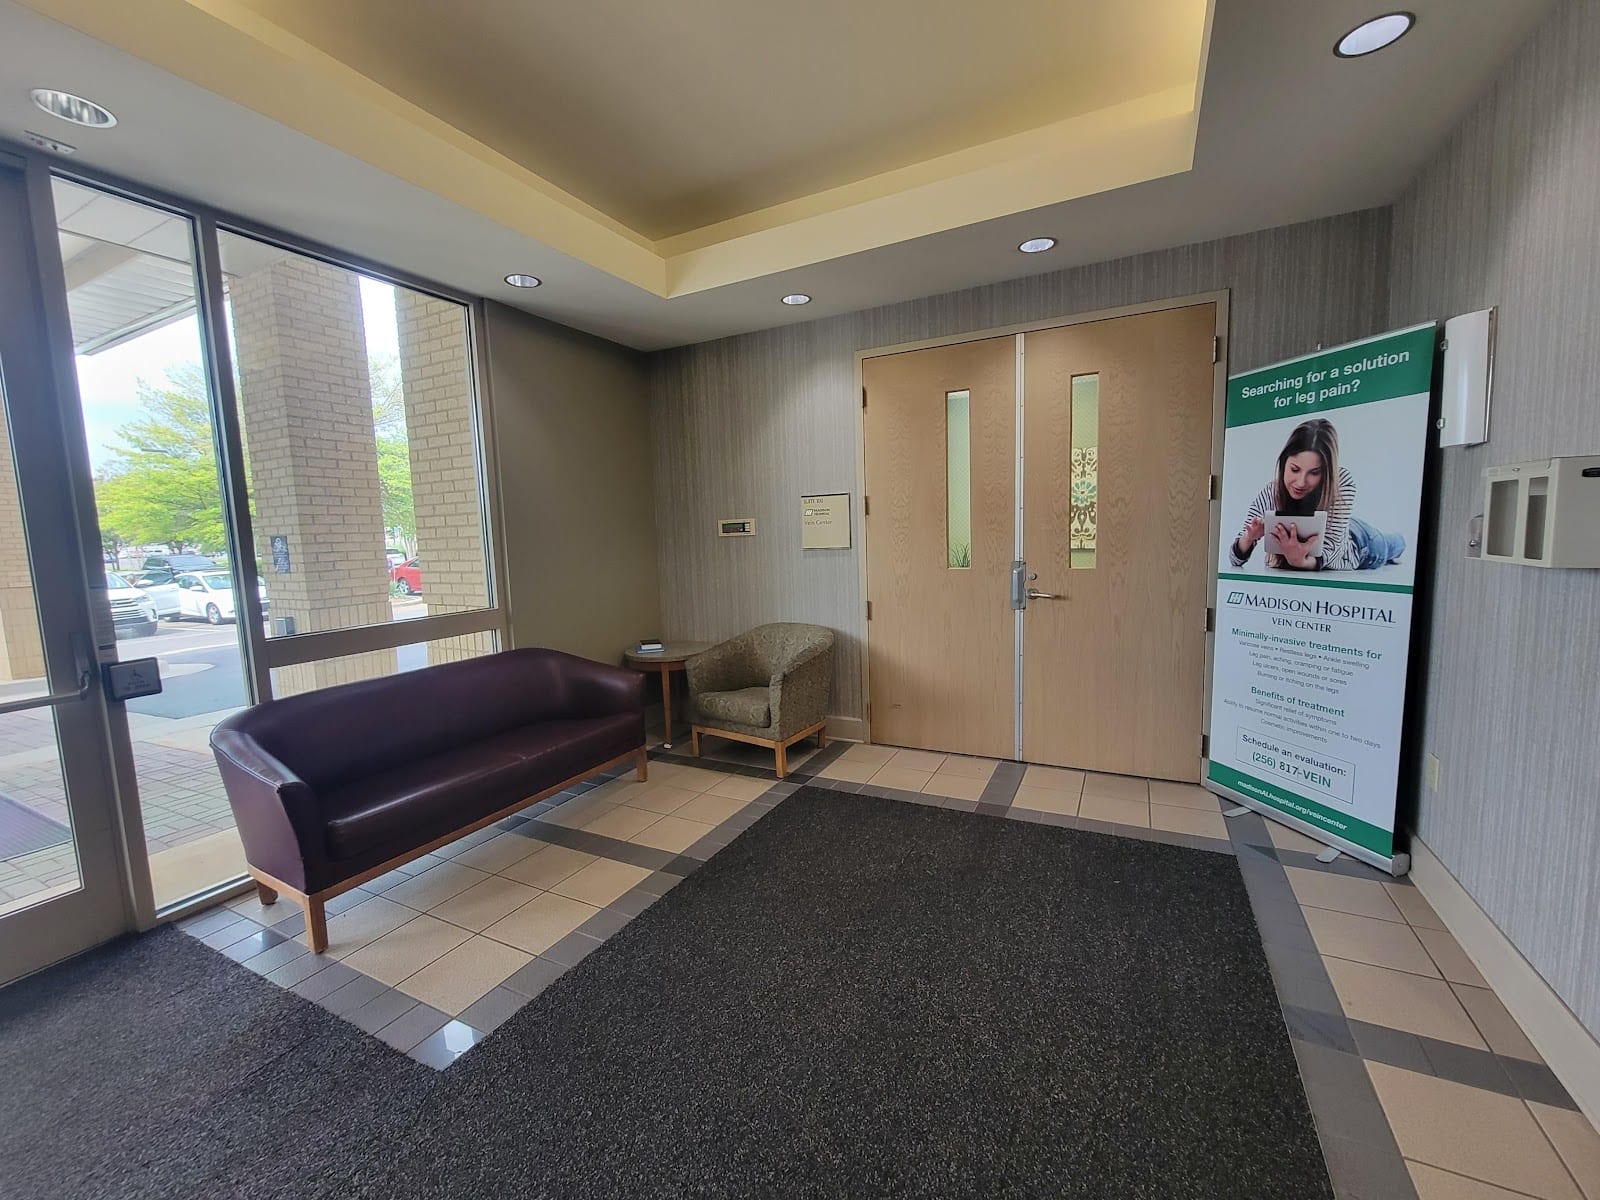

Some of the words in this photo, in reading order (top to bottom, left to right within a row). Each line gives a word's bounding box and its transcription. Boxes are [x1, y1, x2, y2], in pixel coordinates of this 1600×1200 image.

[1241, 376, 1303, 399] Searching
[1306, 369, 1327, 384] for
[1330, 367, 1340, 379] a
[1343, 350, 1410, 375] solution
[1273, 395, 1293, 409] for
[1295, 391, 1316, 405] leg
[1319, 378, 1361, 402] pain?
[1244, 593, 1313, 614] MADISON
[1316, 601, 1397, 624] HOSPITAL
[1271, 616, 1292, 628] VEIN
[1294, 620, 1332, 633] CENTER
[1231, 627, 1307, 648] Minimally-invasive
[1309, 640, 1364, 658] treatments
[1366, 649, 1383, 661] for
[1248, 650, 1259, 659] Leg
[1294, 660, 1322, 671] cramping
[1331, 666, 1354, 677] fatigue
[1252, 659, 1263, 669] Leg
[1281, 667, 1296, 676] open
[1297, 670, 1320, 680] wounds
[1329, 677, 1348, 686] sores
[1304, 652, 1317, 660] legs
[1322, 655, 1342, 664] Ankle
[1342, 659, 1370, 670] swelling
[1257, 669, 1278, 681] Burning
[1285, 676, 1305, 688] itching
[1314, 683, 1325, 691] the
[1325, 686, 1340, 695] legs
[1250, 686, 1285, 702] Benefits
[1286, 696, 1296, 705] of
[1297, 699, 1345, 718] treatment
[1255, 698, 1283, 711] Significant
[1305, 712, 1337, 726] symptoms
[1260, 718, 1285, 730] Cosmetic
[1286, 726, 1328, 744] improvements
[1263, 710, 1283, 720] normal
[1283, 716, 1308, 728] activities
[1308, 723, 1327, 733] within
[1327, 729, 1341, 737] one
[1349, 735, 1363, 744] two
[1363, 739, 1381, 749] days
[1242, 733, 1280, 753] Schedule
[1281, 748, 1293, 759] an
[1294, 753, 1347, 777] evaluation:
[1251, 751, 1277, 770] (256)
[1279, 761, 1332, 789] 817-VEIN
[1237, 779, 1348, 831] madisonALhospital.org/veincenter
